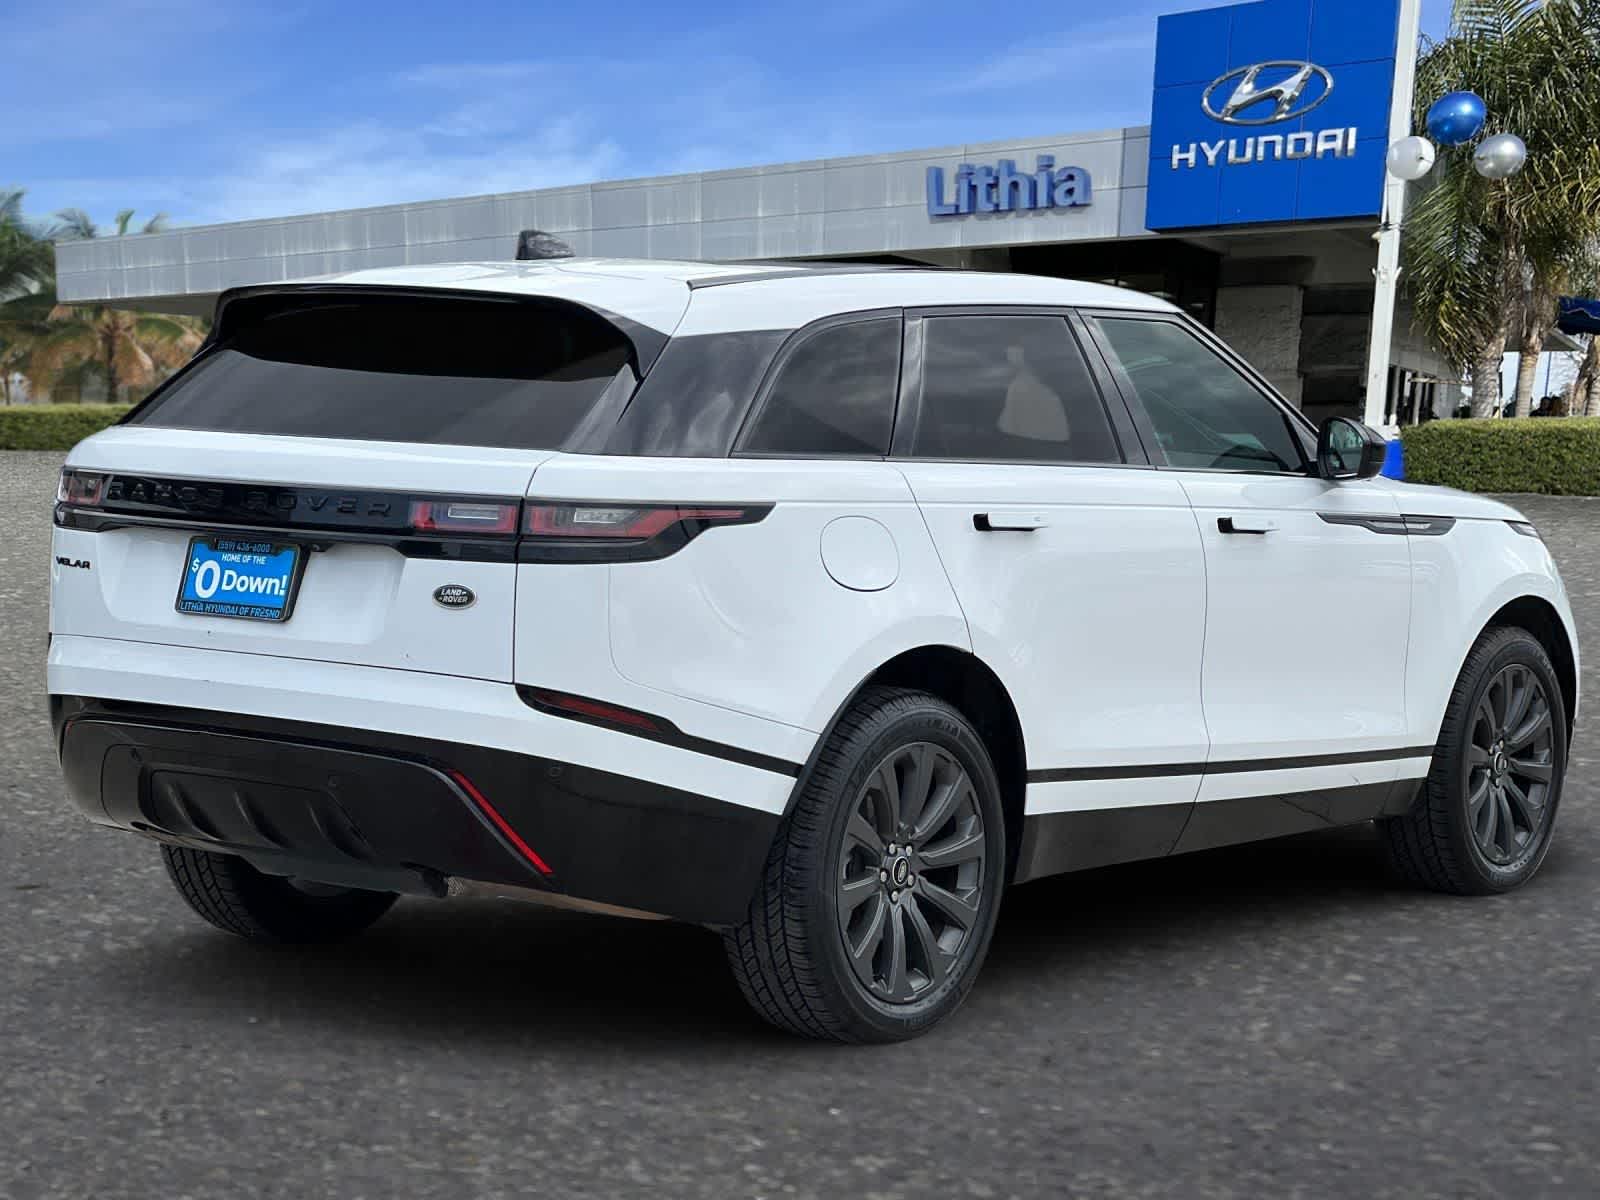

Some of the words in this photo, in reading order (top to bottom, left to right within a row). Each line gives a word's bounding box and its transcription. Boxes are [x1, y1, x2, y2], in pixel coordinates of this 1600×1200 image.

[1170, 126, 1358, 170] HYUNDAI
[925, 155, 1092, 217] Lithia
[248, 492, 392, 517] ROVER
[55, 555, 91, 570] VELAR
[221, 553, 241, 564] HOME
[241, 554, 252, 564] OF
[252, 555, 267, 565] THE
[221, 569, 288, 596] Down!
[441, 588, 463, 596] LAND
[442, 595, 468, 603] ROVER
[180, 601, 204, 611] LITHIA
[204, 603, 238, 615] HYUNDAI
[239, 605, 250, 616] OF
[250, 606, 280, 619] FRESNO
